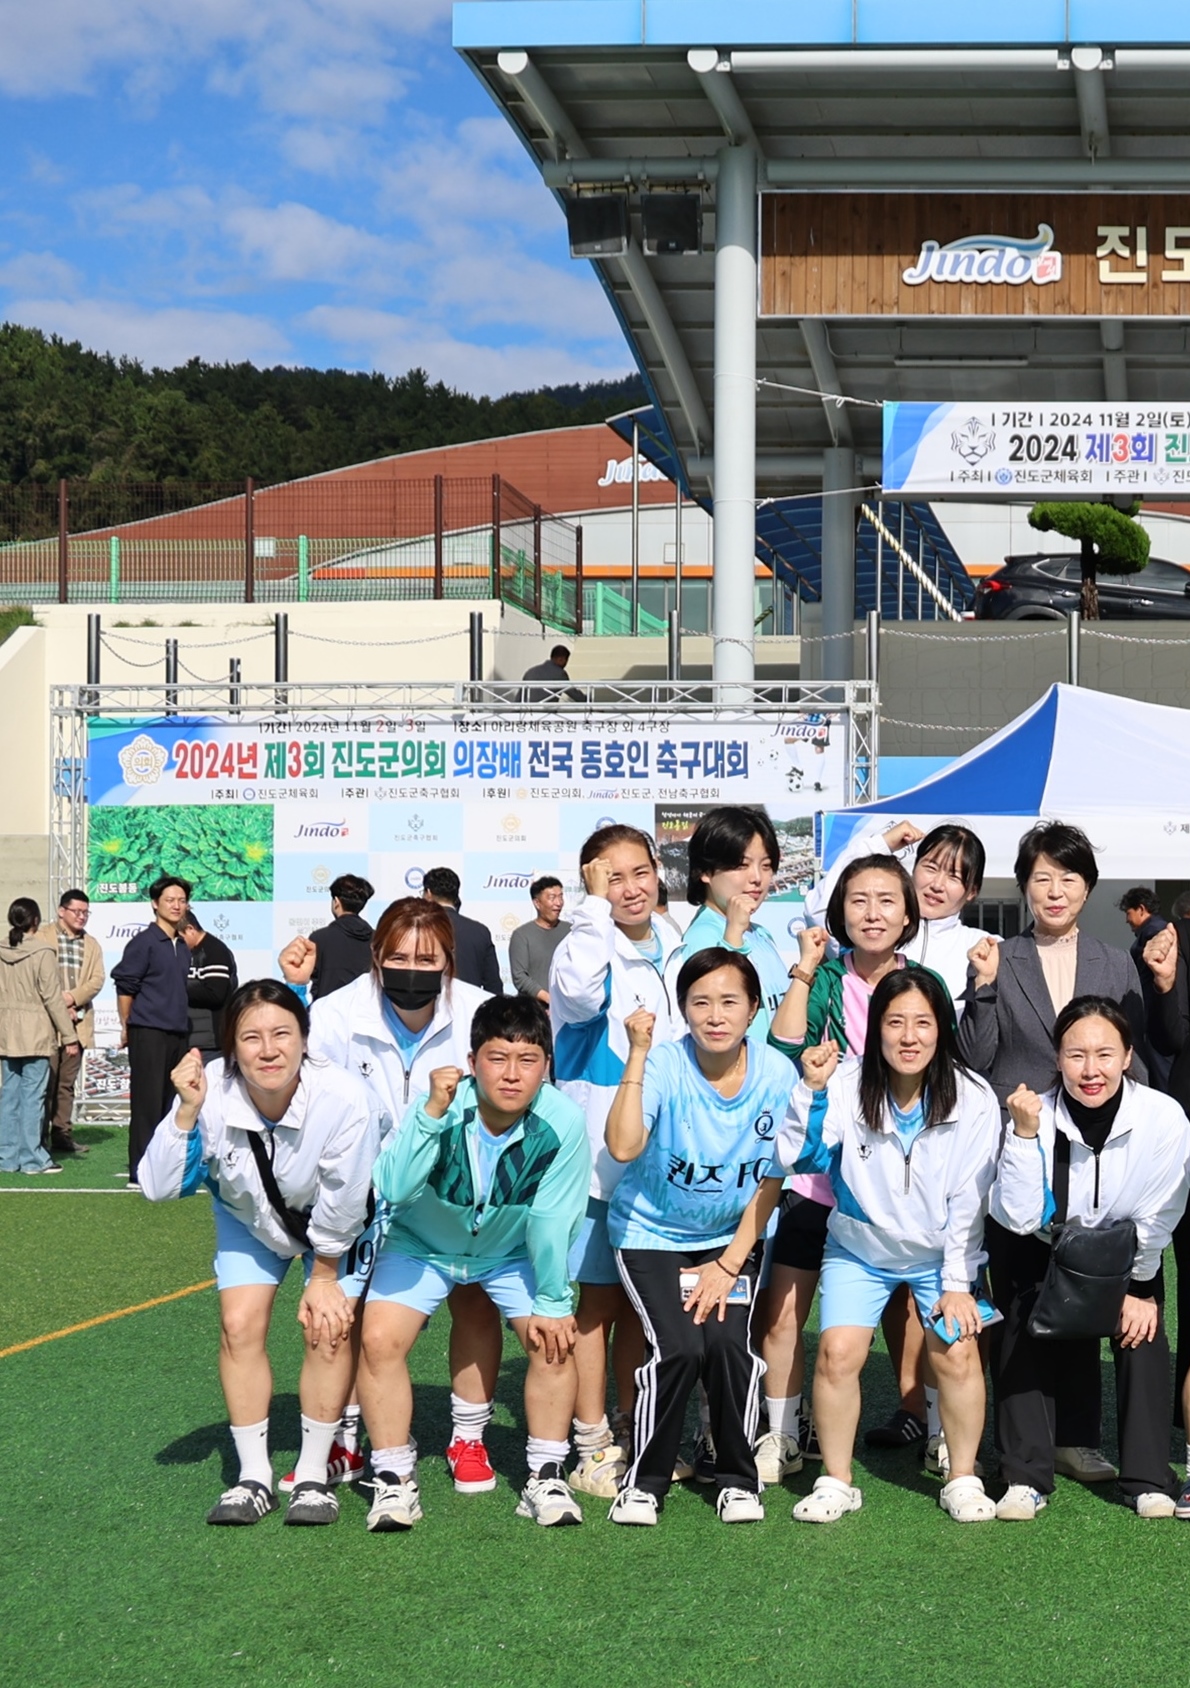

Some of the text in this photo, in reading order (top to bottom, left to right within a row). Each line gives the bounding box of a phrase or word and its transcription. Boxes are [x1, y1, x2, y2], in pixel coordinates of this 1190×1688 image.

[903, 238, 1036, 284] Jindo
[1001, 411, 1034, 428] 기간
[1049, 412, 1093, 427] 2024
[1098, 411, 1130, 428] 11월
[1008, 432, 1078, 463] 2024
[1084, 431, 1156, 464] 제3회
[957, 468, 984, 484] 주최
[1013, 468, 1093, 485] 진도군체육회
[1113, 468, 1140, 485] 주관
[296, 720, 340, 734] 2024년
[344, 720, 371, 733] 11월
[491, 720, 578, 734] 아리랑체육공원
[581, 720, 618, 734] 축구장
[623, 720, 634, 733] 외
[637, 720, 671, 734] 4구장
[770, 722, 817, 738] Jindo
[174, 739, 749, 780] 2024년 제3회 진도군의회 의장배 전국 동호인 축구대회
[257, 788, 319, 800] 진도군체육회
[388, 786, 460, 799] 진도군축구협회
[657, 787, 721, 799] 전남축구협회
[293, 824, 340, 838] Jindo
[482, 873, 529, 889] Jindo
[106, 924, 147, 939] Jind
[666, 1153, 724, 1194] 퀸즈
